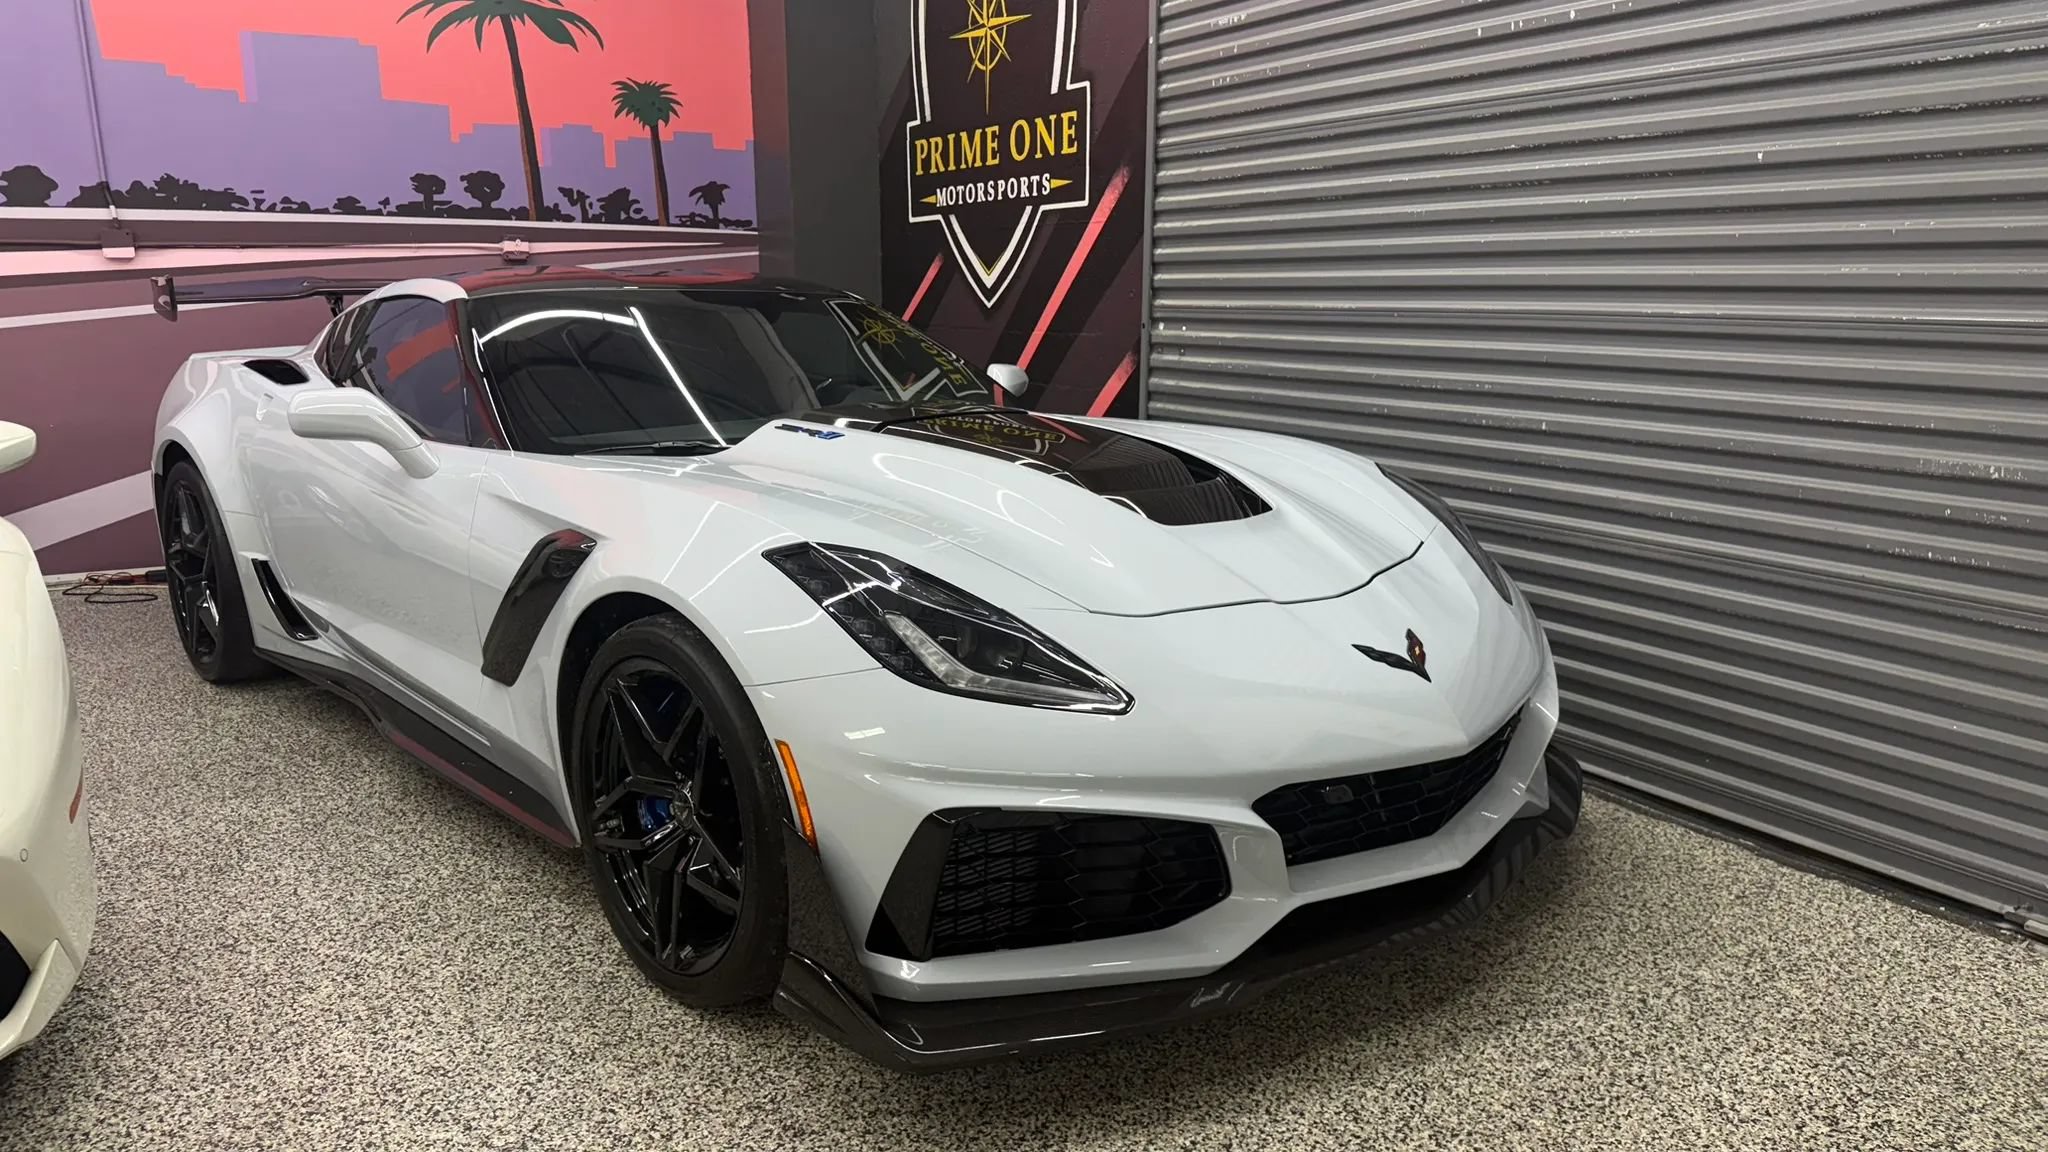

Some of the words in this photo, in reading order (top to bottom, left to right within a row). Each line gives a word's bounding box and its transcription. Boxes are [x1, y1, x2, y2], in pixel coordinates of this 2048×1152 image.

[915, 125, 1000, 176] PRIME
[1009, 110, 1078, 162] ONE
[936, 173, 1050, 207] MOTORSPORTS
